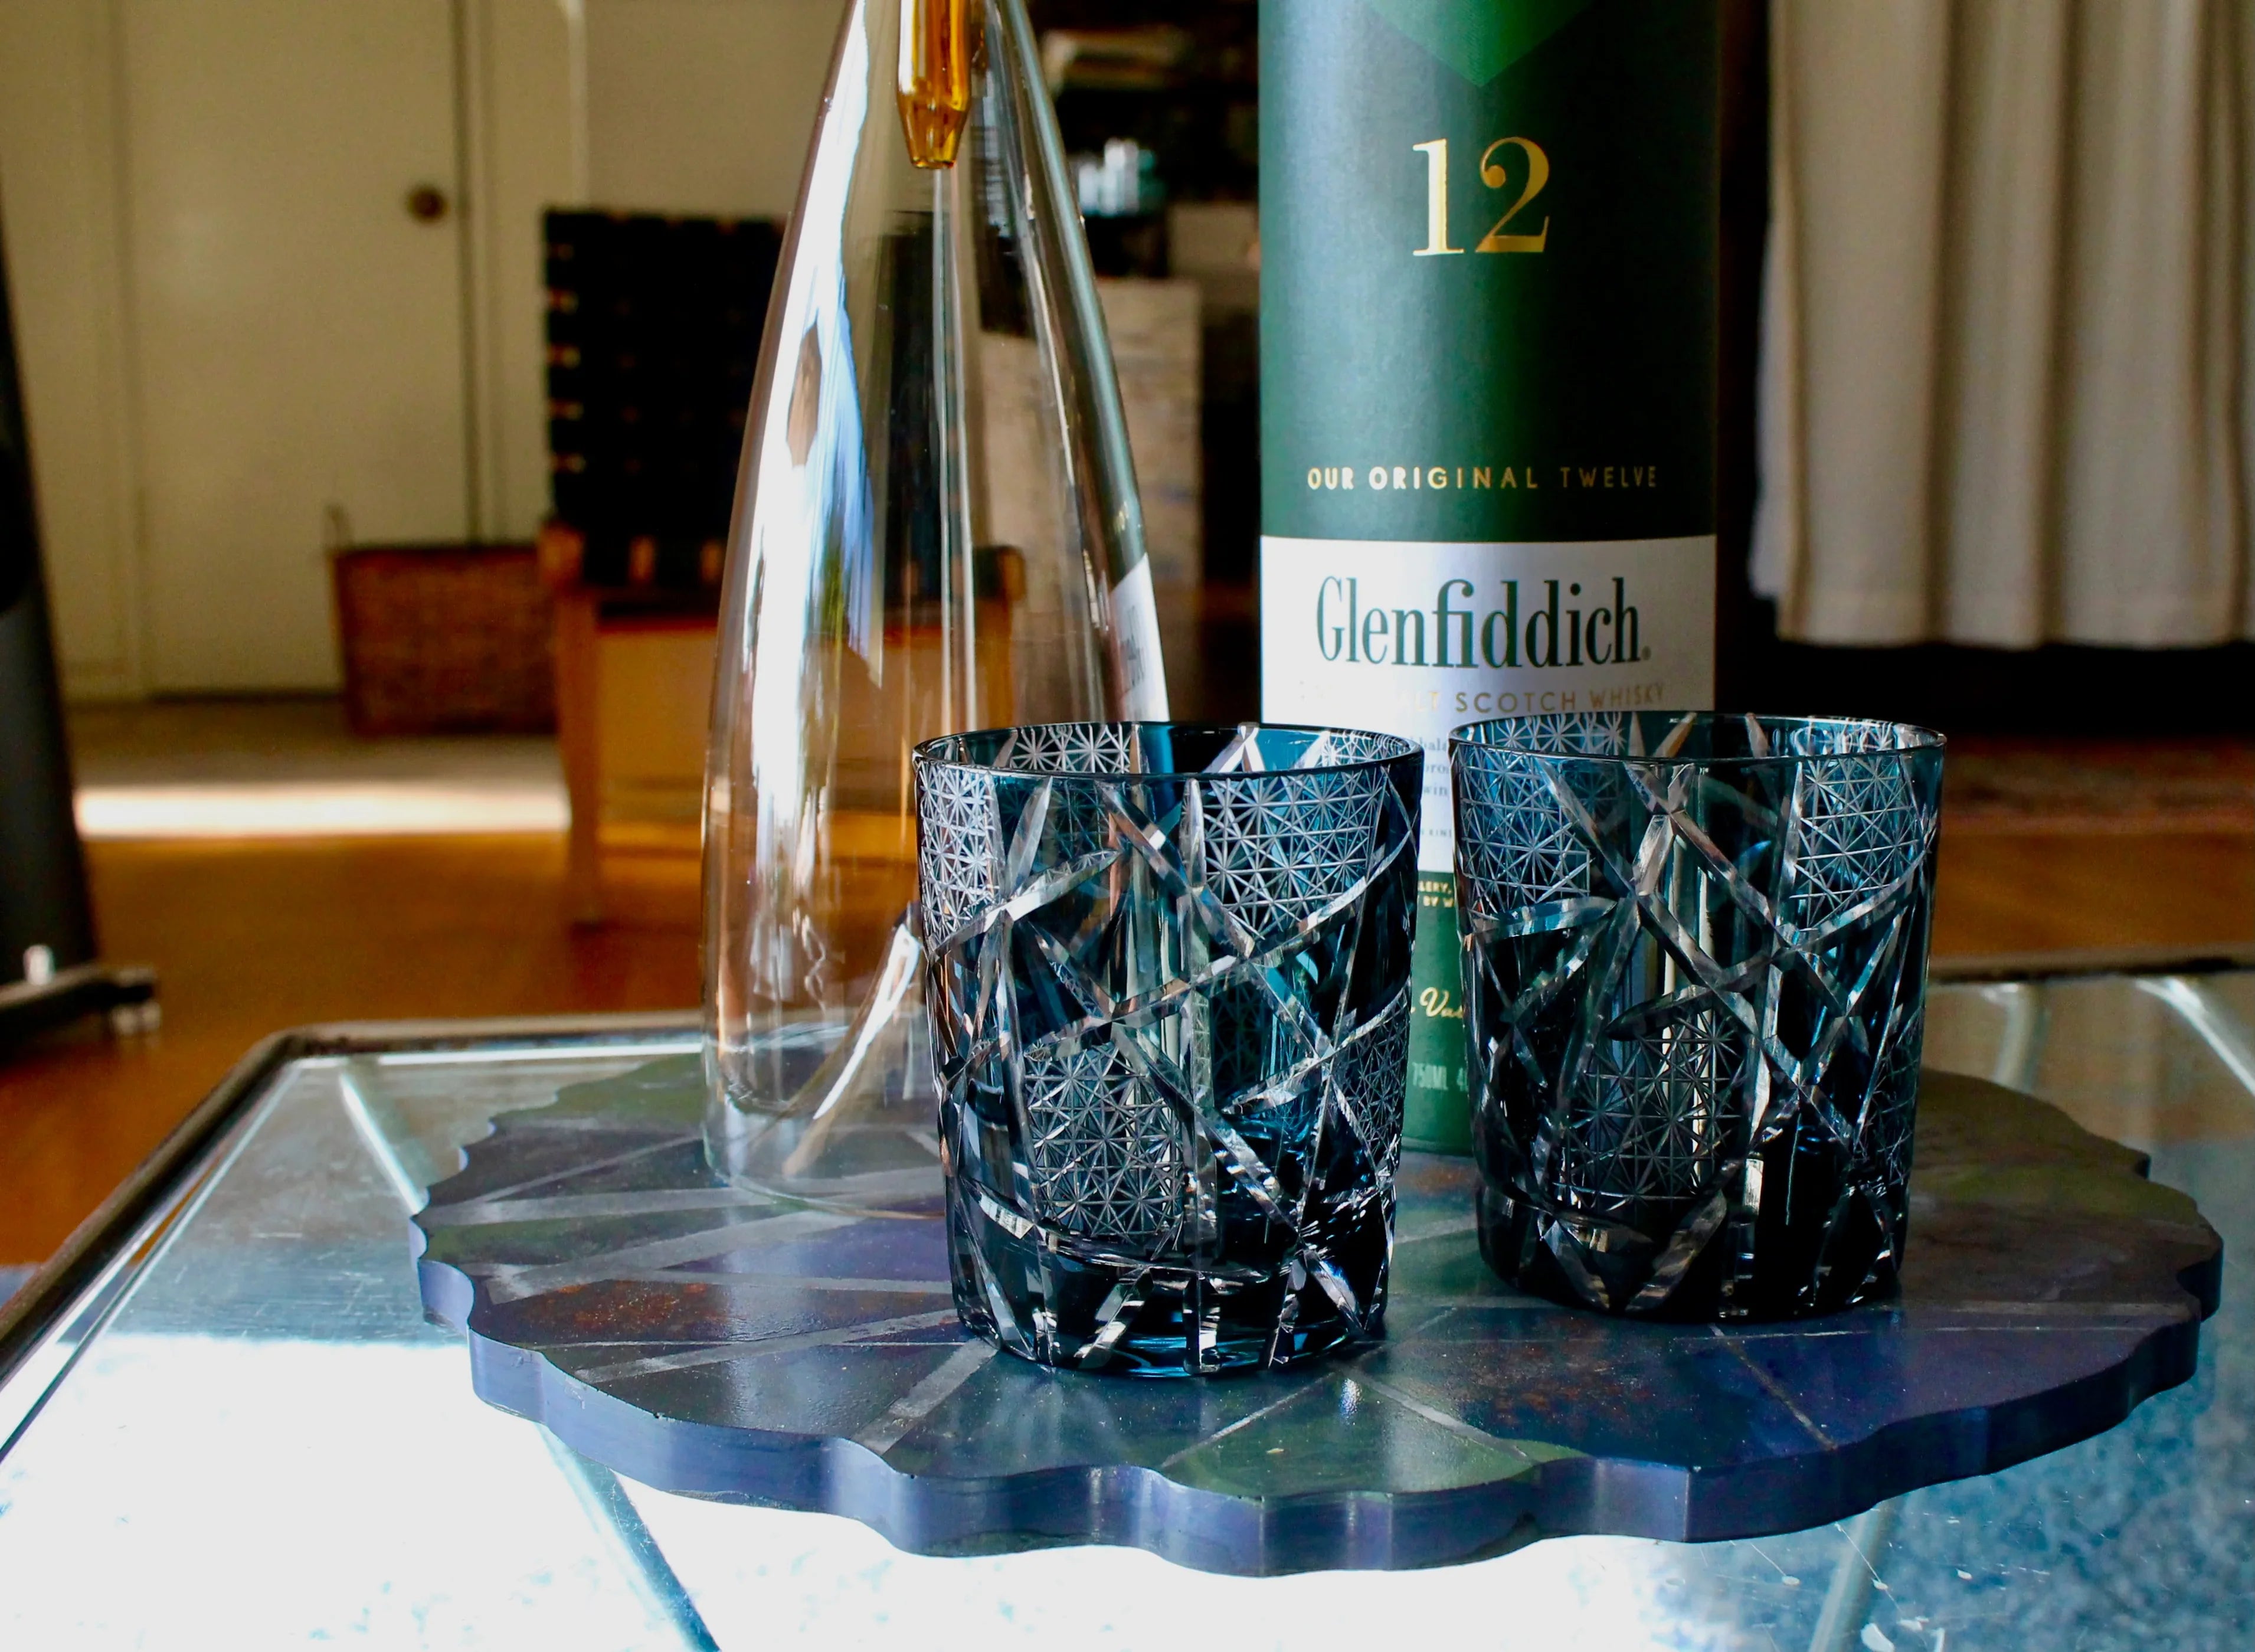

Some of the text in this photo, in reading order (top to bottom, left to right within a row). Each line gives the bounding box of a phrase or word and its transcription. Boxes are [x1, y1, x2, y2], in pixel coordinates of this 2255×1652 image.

[1412, 136, 1550, 256] 12
[1307, 466, 1657, 490] OUR ORIGINAL TWELVE
[1317, 575, 1641, 669] Glenfiddich
[1455, 691, 1576, 713] SCOTCH
[1589, 682, 1664, 709] WHISKY
